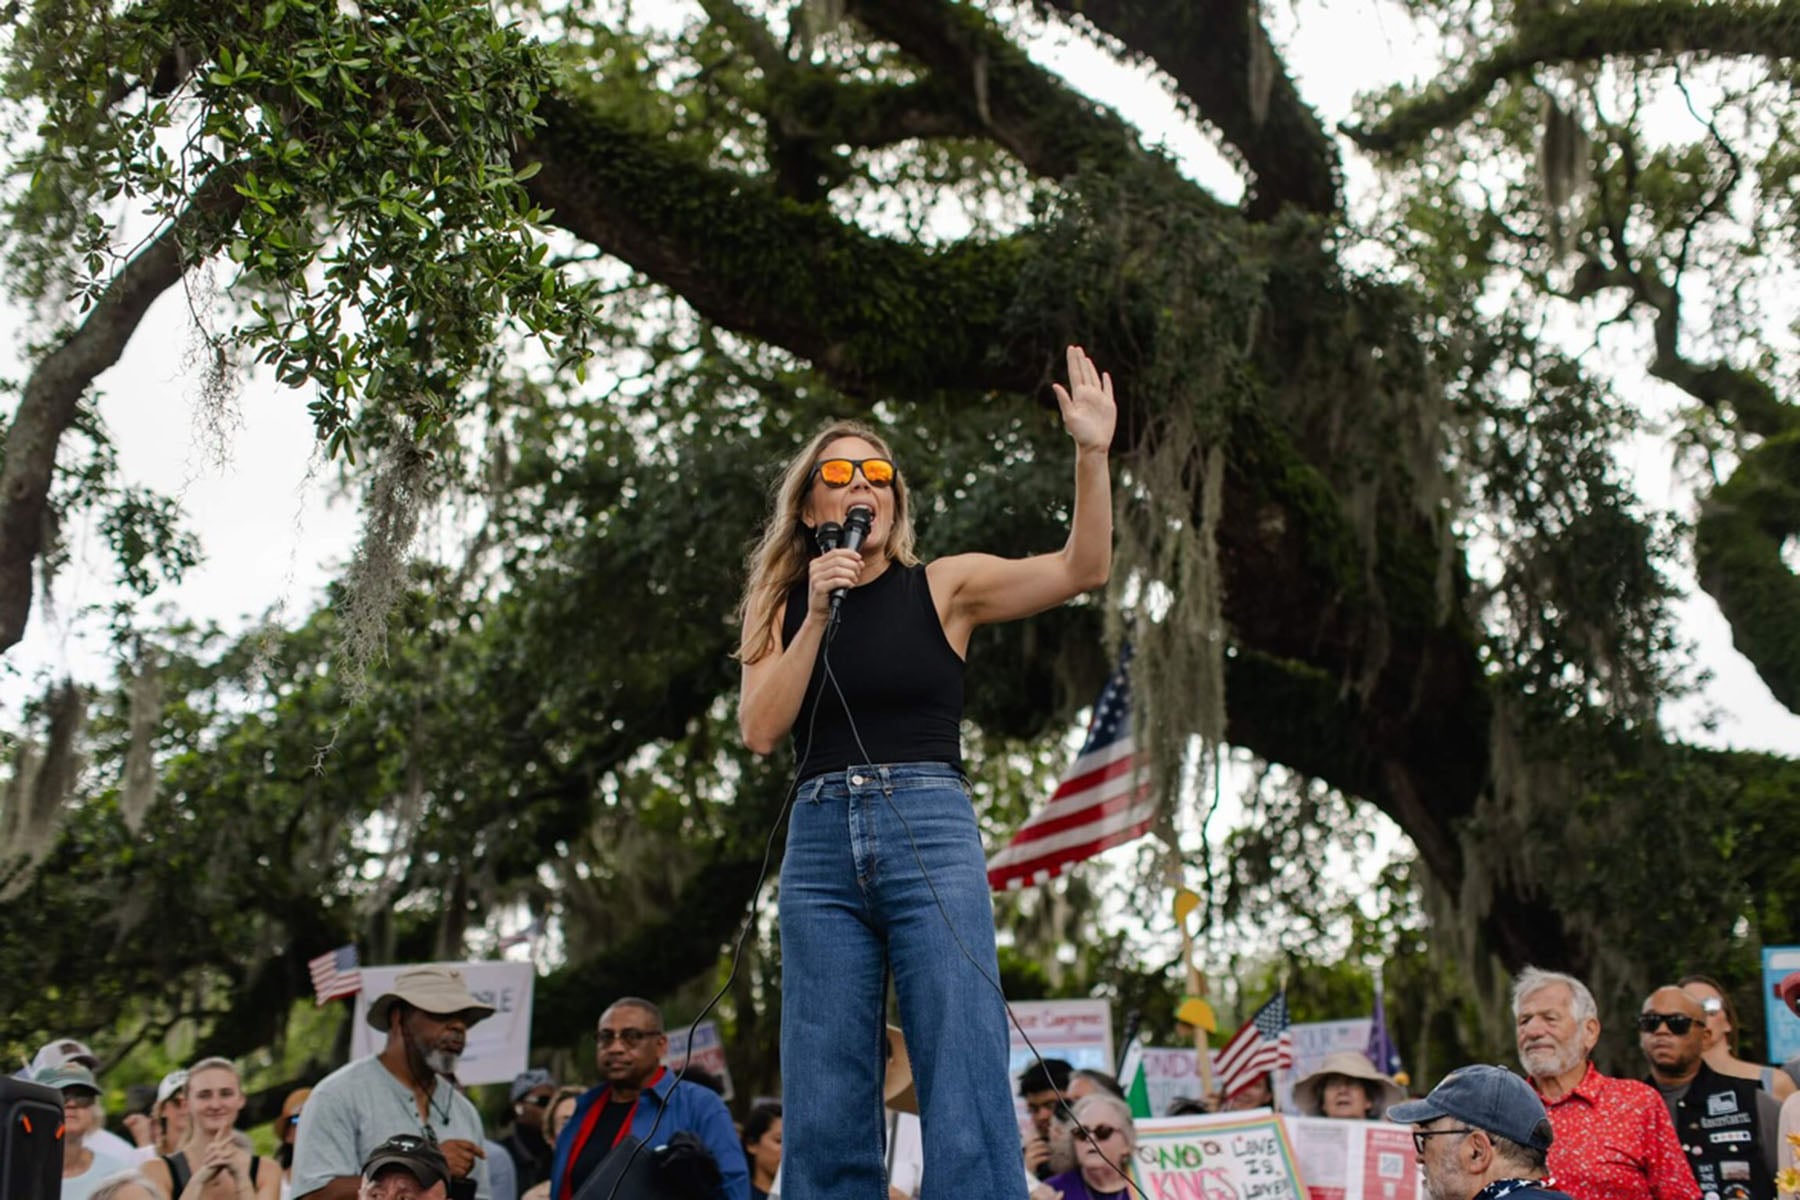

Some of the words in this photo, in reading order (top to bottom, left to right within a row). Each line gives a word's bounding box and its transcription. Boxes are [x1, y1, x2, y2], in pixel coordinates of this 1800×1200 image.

[1159, 1144, 1202, 1170] NO
[1231, 1137, 1277, 1158] LOVE
[1149, 1167, 1239, 1200] KINGS
